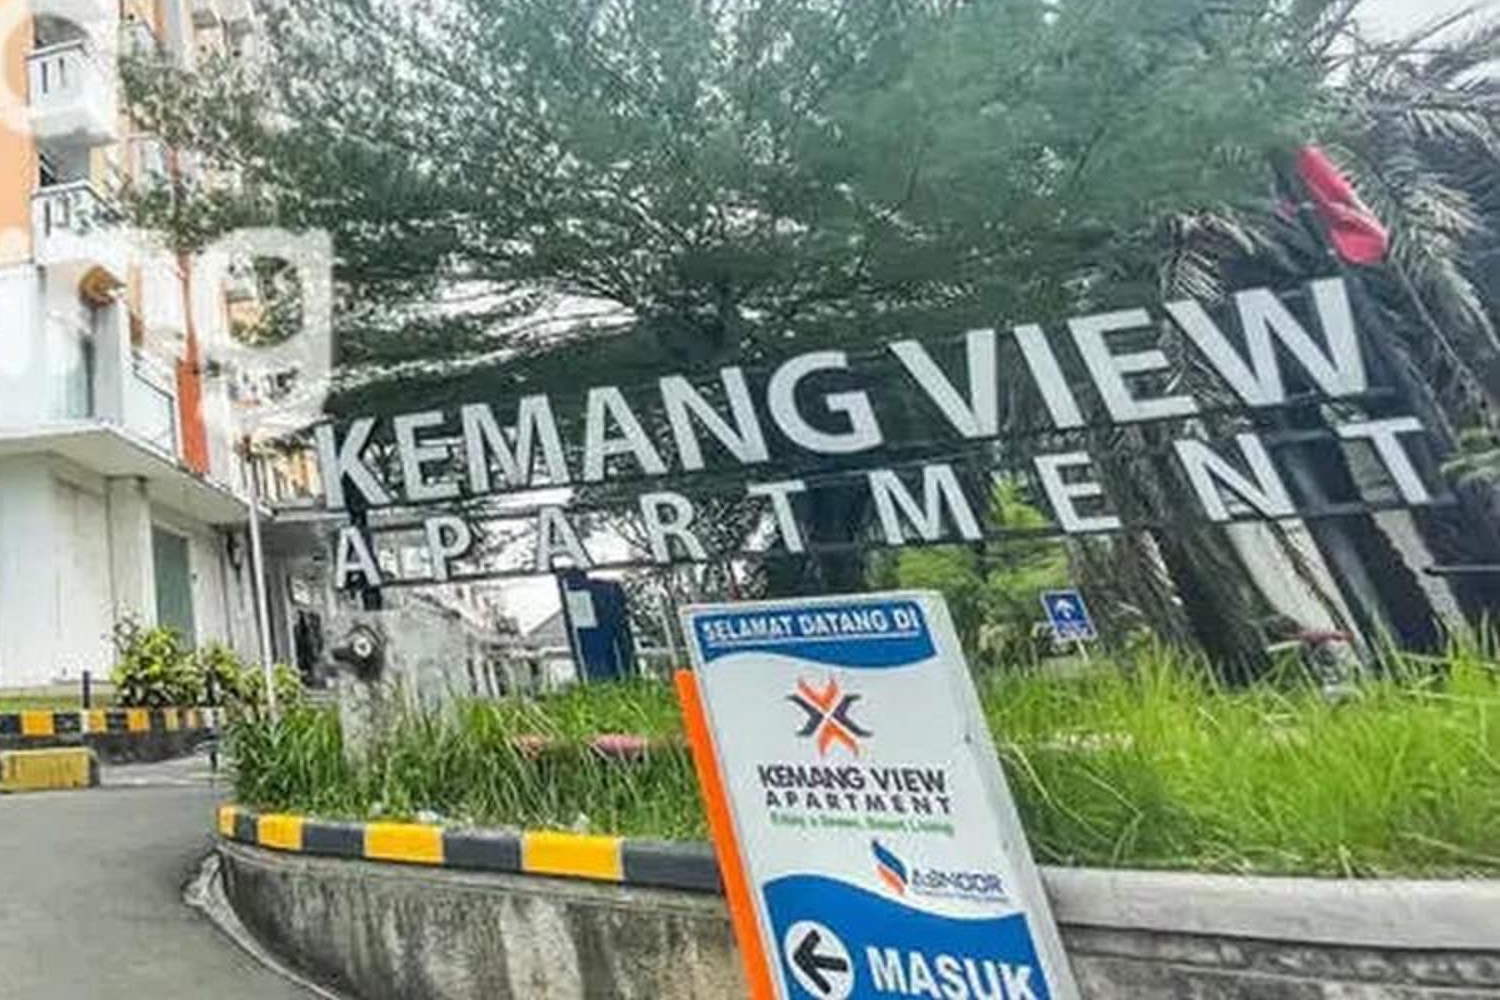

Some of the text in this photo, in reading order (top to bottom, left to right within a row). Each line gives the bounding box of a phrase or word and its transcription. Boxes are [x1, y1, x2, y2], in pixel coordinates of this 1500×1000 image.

[320, 276, 1370, 510] KEMANG VIEW
[335, 415, 1428, 590] APARTMENT
[703, 604, 920, 642] SELAMAT DATANG DI
[758, 765, 946, 793] KEMANG VIEW
[766, 790, 951, 814] APARTMENT
[866, 946, 1038, 1000] MASUK
